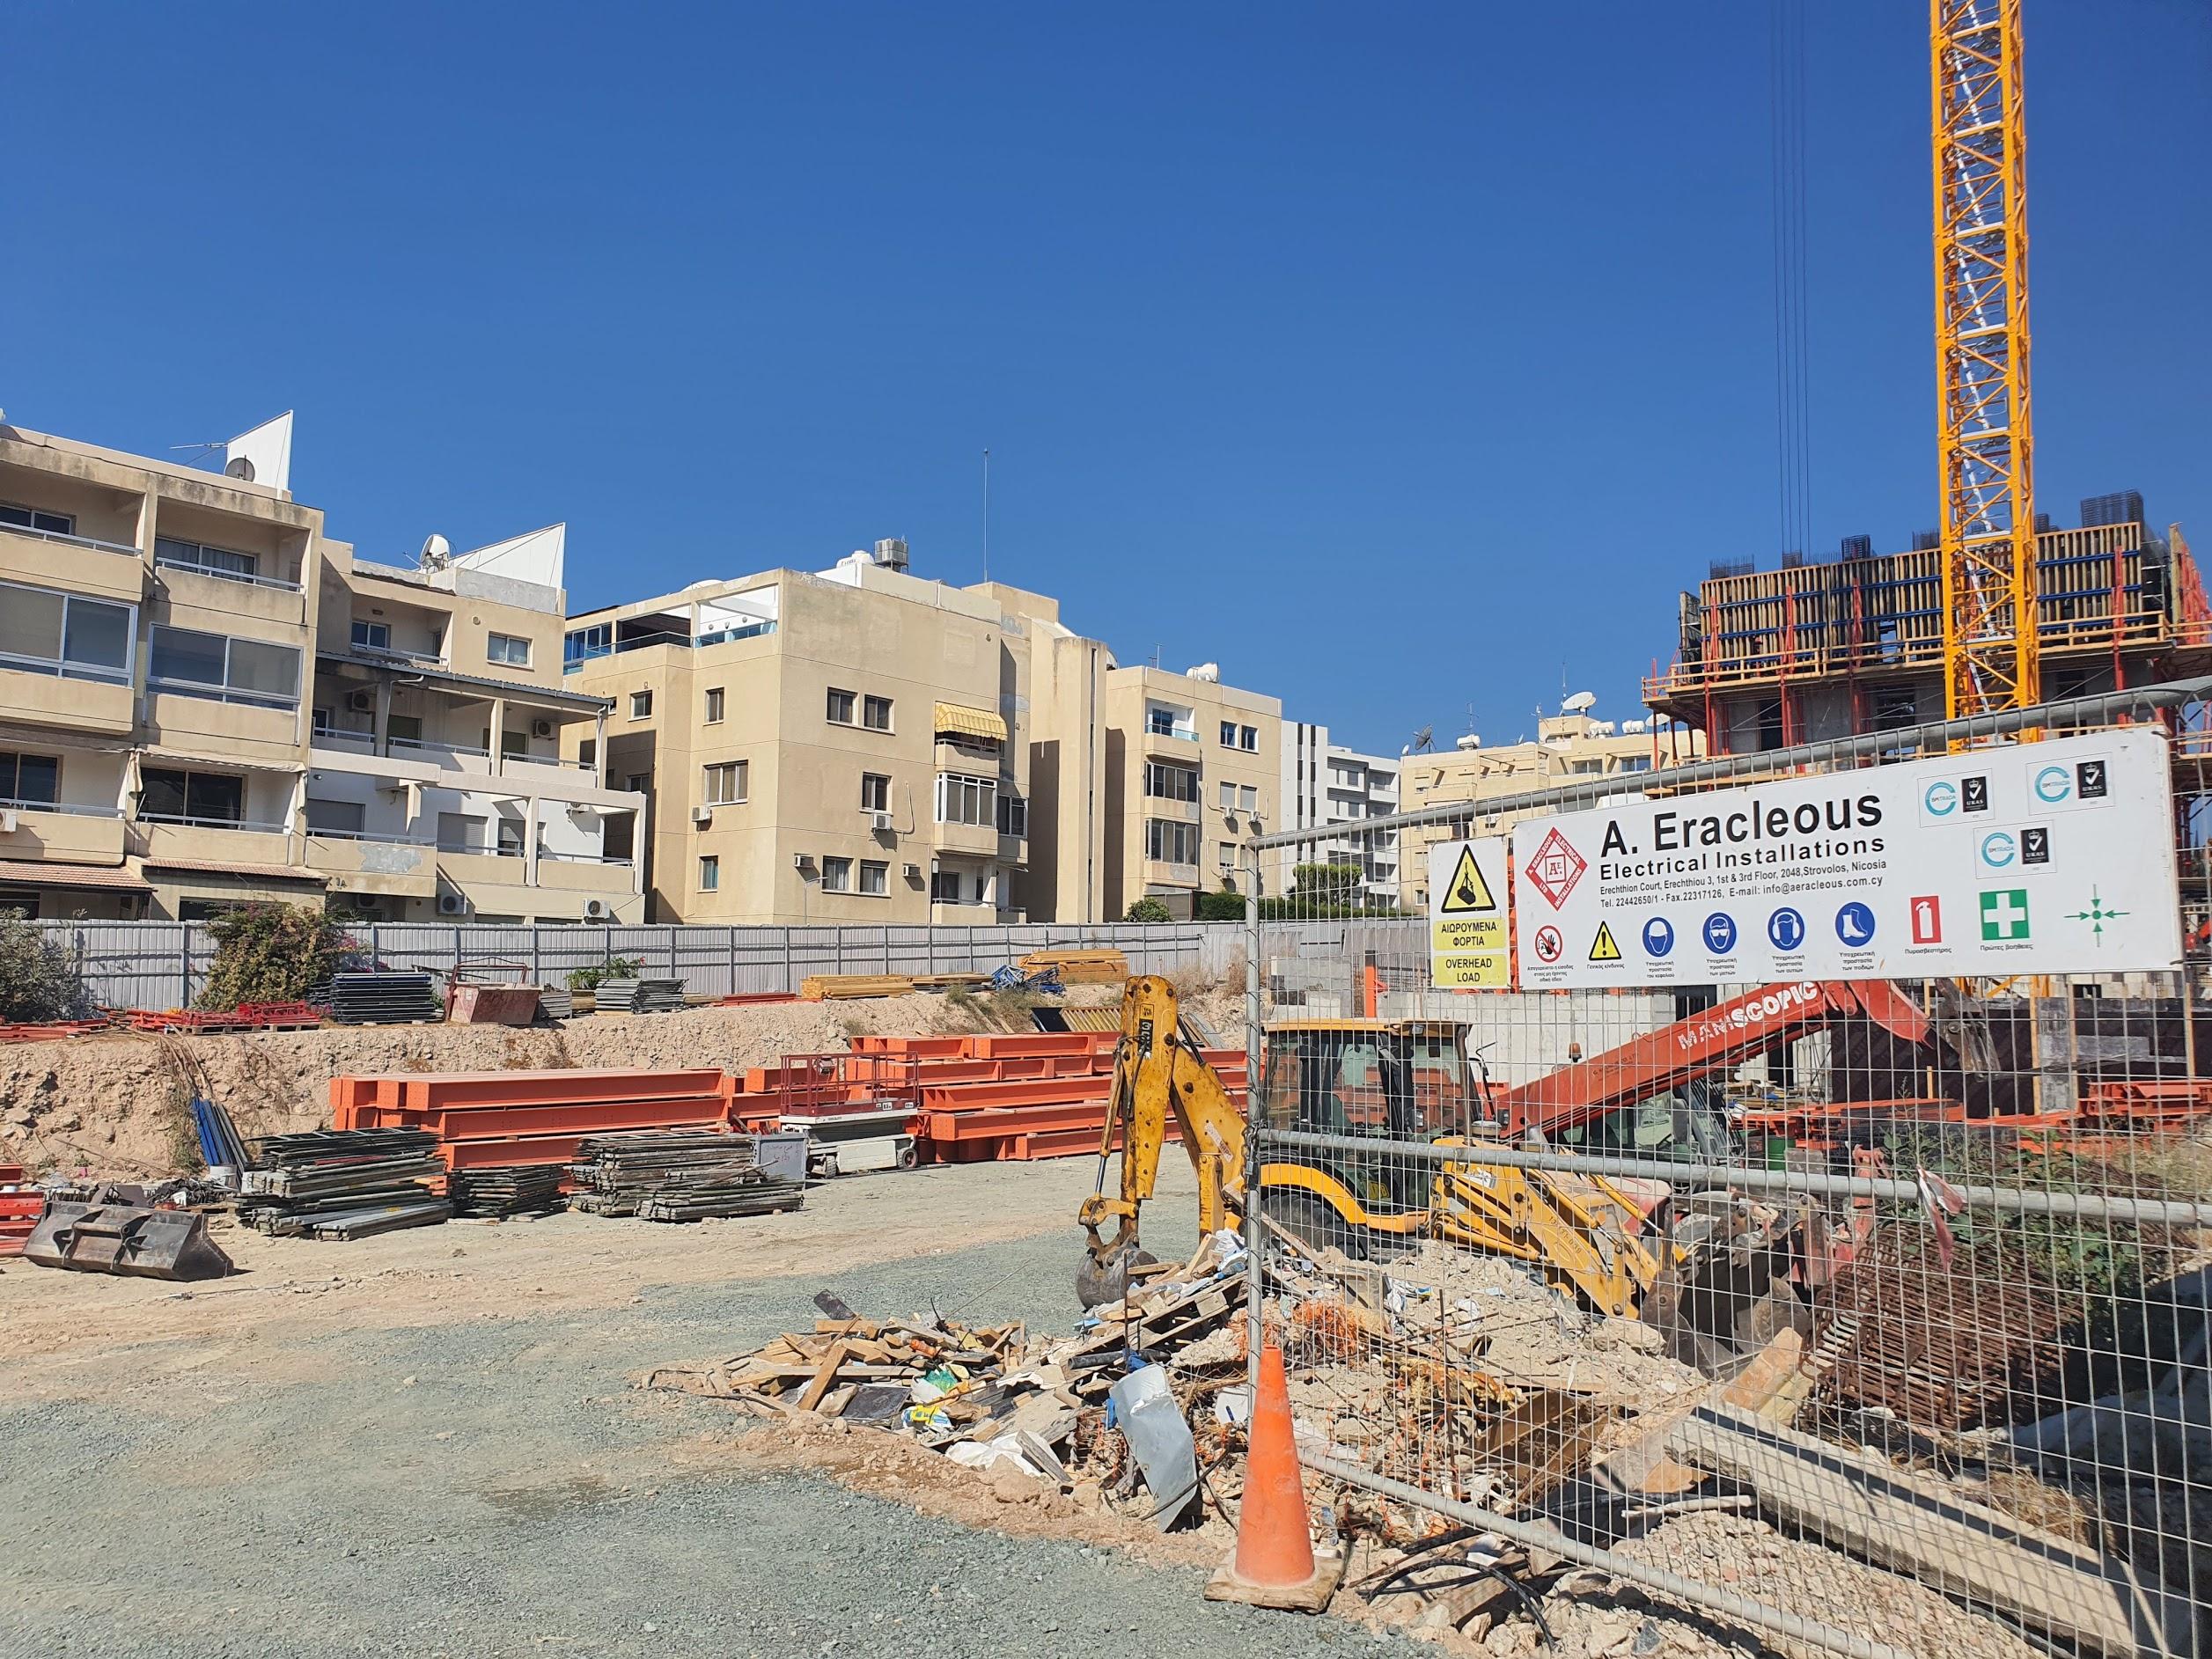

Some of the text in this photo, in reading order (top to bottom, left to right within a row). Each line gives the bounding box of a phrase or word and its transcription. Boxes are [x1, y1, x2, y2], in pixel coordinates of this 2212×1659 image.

[1600, 794, 1883, 858] A. Eracleous
[1532, 835, 1554, 869] ERACLEOUS
[1554, 834, 1581, 865] ELECTRICAL
[1599, 837, 1885, 881] Electrical Installations
[1538, 883, 1548, 893] LTD
[1554, 866, 1583, 908] INSTALLATIONS
[1600, 880, 1638, 895] Erechthion
[1640, 883, 1663, 892] Court,
[1664, 877, 1706, 889] Erechthiou
[1707, 876, 1715, 886] 3,
[1716, 875, 1730, 885] 1st
[1731, 874, 1738, 883] &
[1738, 871, 1753, 882] 3rd
[1754, 870, 1779, 881] Floor,
[1851, 859, 1886, 871] Nicosia
[1600, 899, 1614, 908] Tel.
[1615, 894, 1658, 907] 22442650/1
[1665, 888, 1725, 902] Fax.22317126,
[1729, 885, 1760, 897] E-mail:
[1762, 876, 1883, 895] info@aeracleous.com.cy
[1441, 921, 1497, 933] ΑΙΩΡΟΥΜΕΝΑ
[1452, 936, 1485, 946] ΦΟΡΤΙΑ
[1445, 958, 1492, 969] OVERHEAD
[1457, 973, 1481, 982] LOAD
